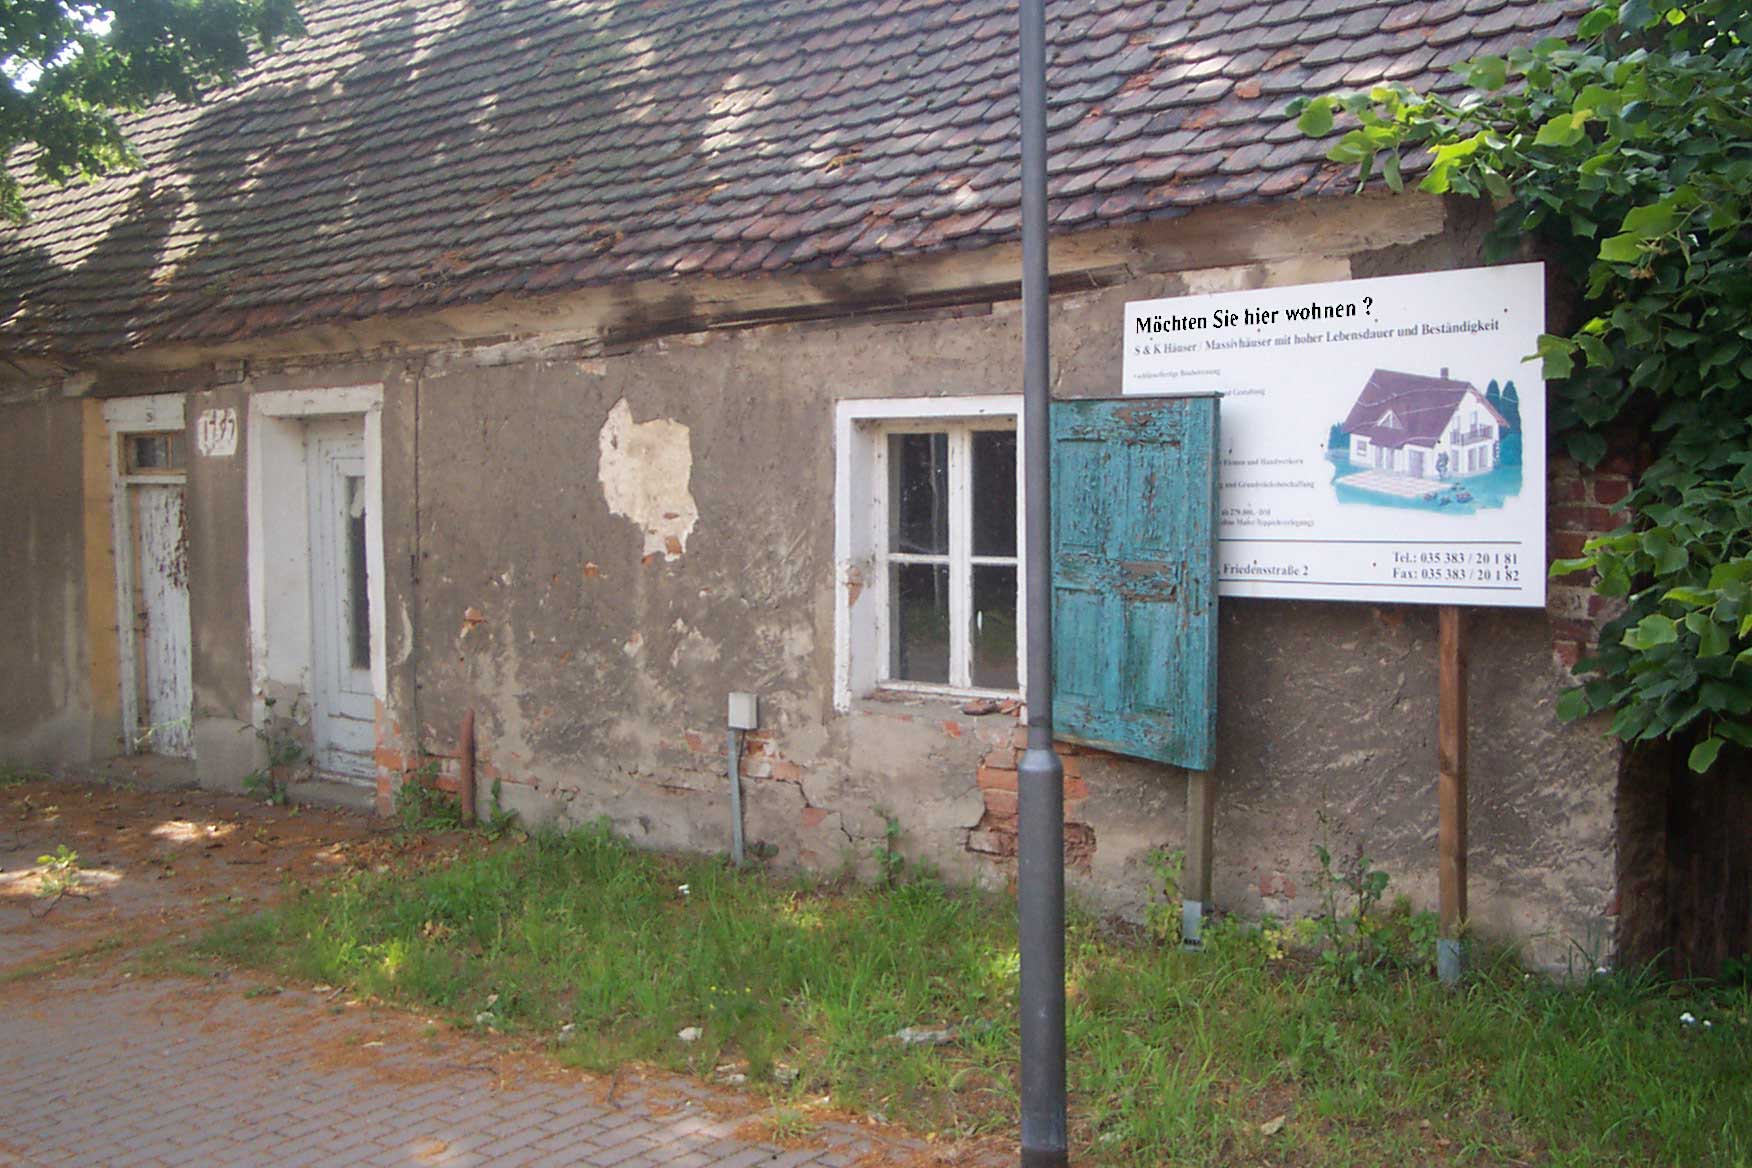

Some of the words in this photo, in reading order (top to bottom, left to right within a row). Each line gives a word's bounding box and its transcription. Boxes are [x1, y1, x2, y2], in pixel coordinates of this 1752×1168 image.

[1136, 315, 1207, 334] Möchten
[1213, 309, 1239, 329] Sie
[1244, 307, 1279, 326] hier
[1285, 302, 1356, 321] wohnen
[1362, 296, 1374, 316] ?
[1135, 346, 1141, 356] S
[1142, 345, 1151, 355] &
[1153, 344, 1162, 354] K
[1164, 342, 1196, 353] Häuser
[1205, 336, 1272, 351] Massivhäuser
[1274, 334, 1292, 346] mit
[1294, 332, 1322, 345] hoher
[1326, 328, 1394, 343] Lebensdauer
[1398, 324, 1418, 337] und
[1422, 319, 1499, 335] Beständigkeit
[1393, 551, 1417, 563] Tel.:
[1420, 552, 1441, 563] 035
[1444, 552, 1465, 563] 383
[1476, 552, 1490, 564] 20
[1494, 553, 1499, 564] 1
[1504, 553, 1518, 565] 81
[1223, 563, 1300, 576] Friedensstraße
[1302, 565, 1309, 576] 2
[1393, 567, 1418, 579] Fax:
[1421, 568, 1442, 579] 035
[1445, 569, 1466, 580] 383
[1477, 569, 1491, 581] 20
[1496, 570, 1501, 581] 1
[1505, 570, 1520, 582] 82
